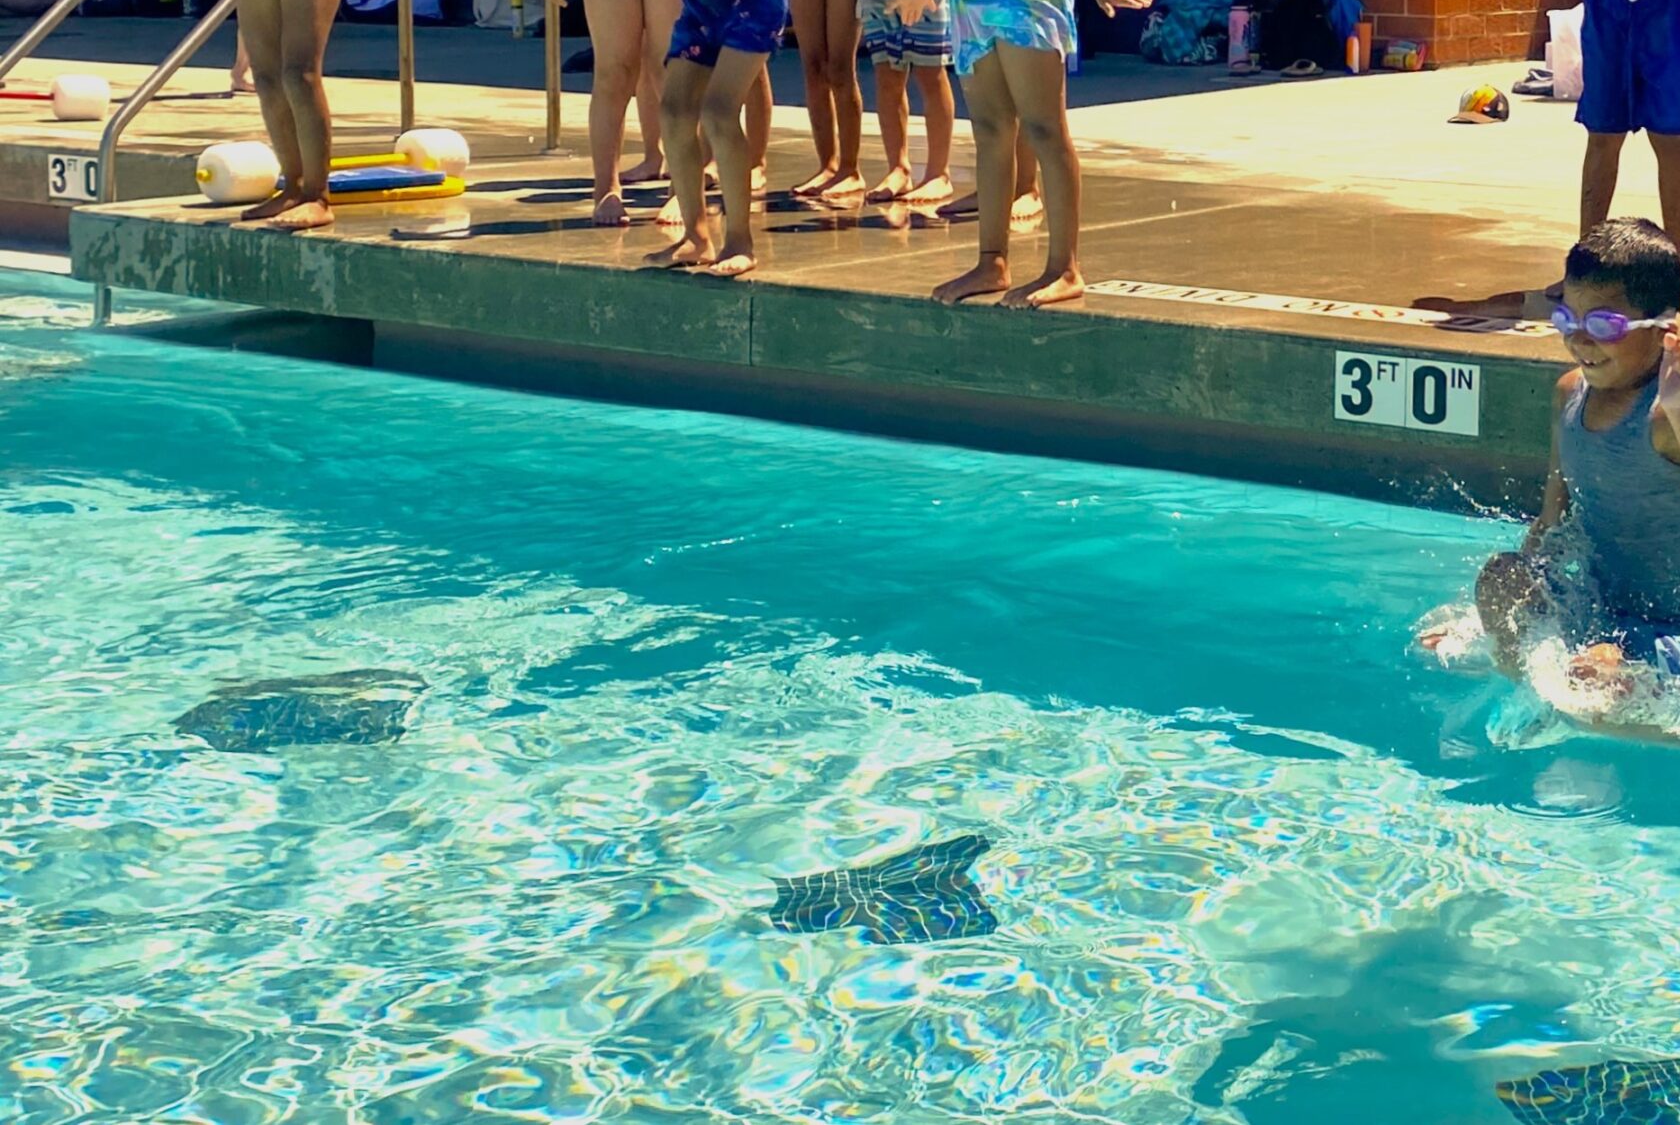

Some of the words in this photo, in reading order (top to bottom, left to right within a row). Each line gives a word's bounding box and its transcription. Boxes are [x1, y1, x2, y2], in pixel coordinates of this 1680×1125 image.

[51, 158, 66, 193] 3
[67, 158, 78, 172] FT
[1341, 358, 1373, 416] 3
[1376, 360, 1400, 382] FT
[1412, 365, 1447, 425] 0
[1451, 367, 1473, 390] IN
